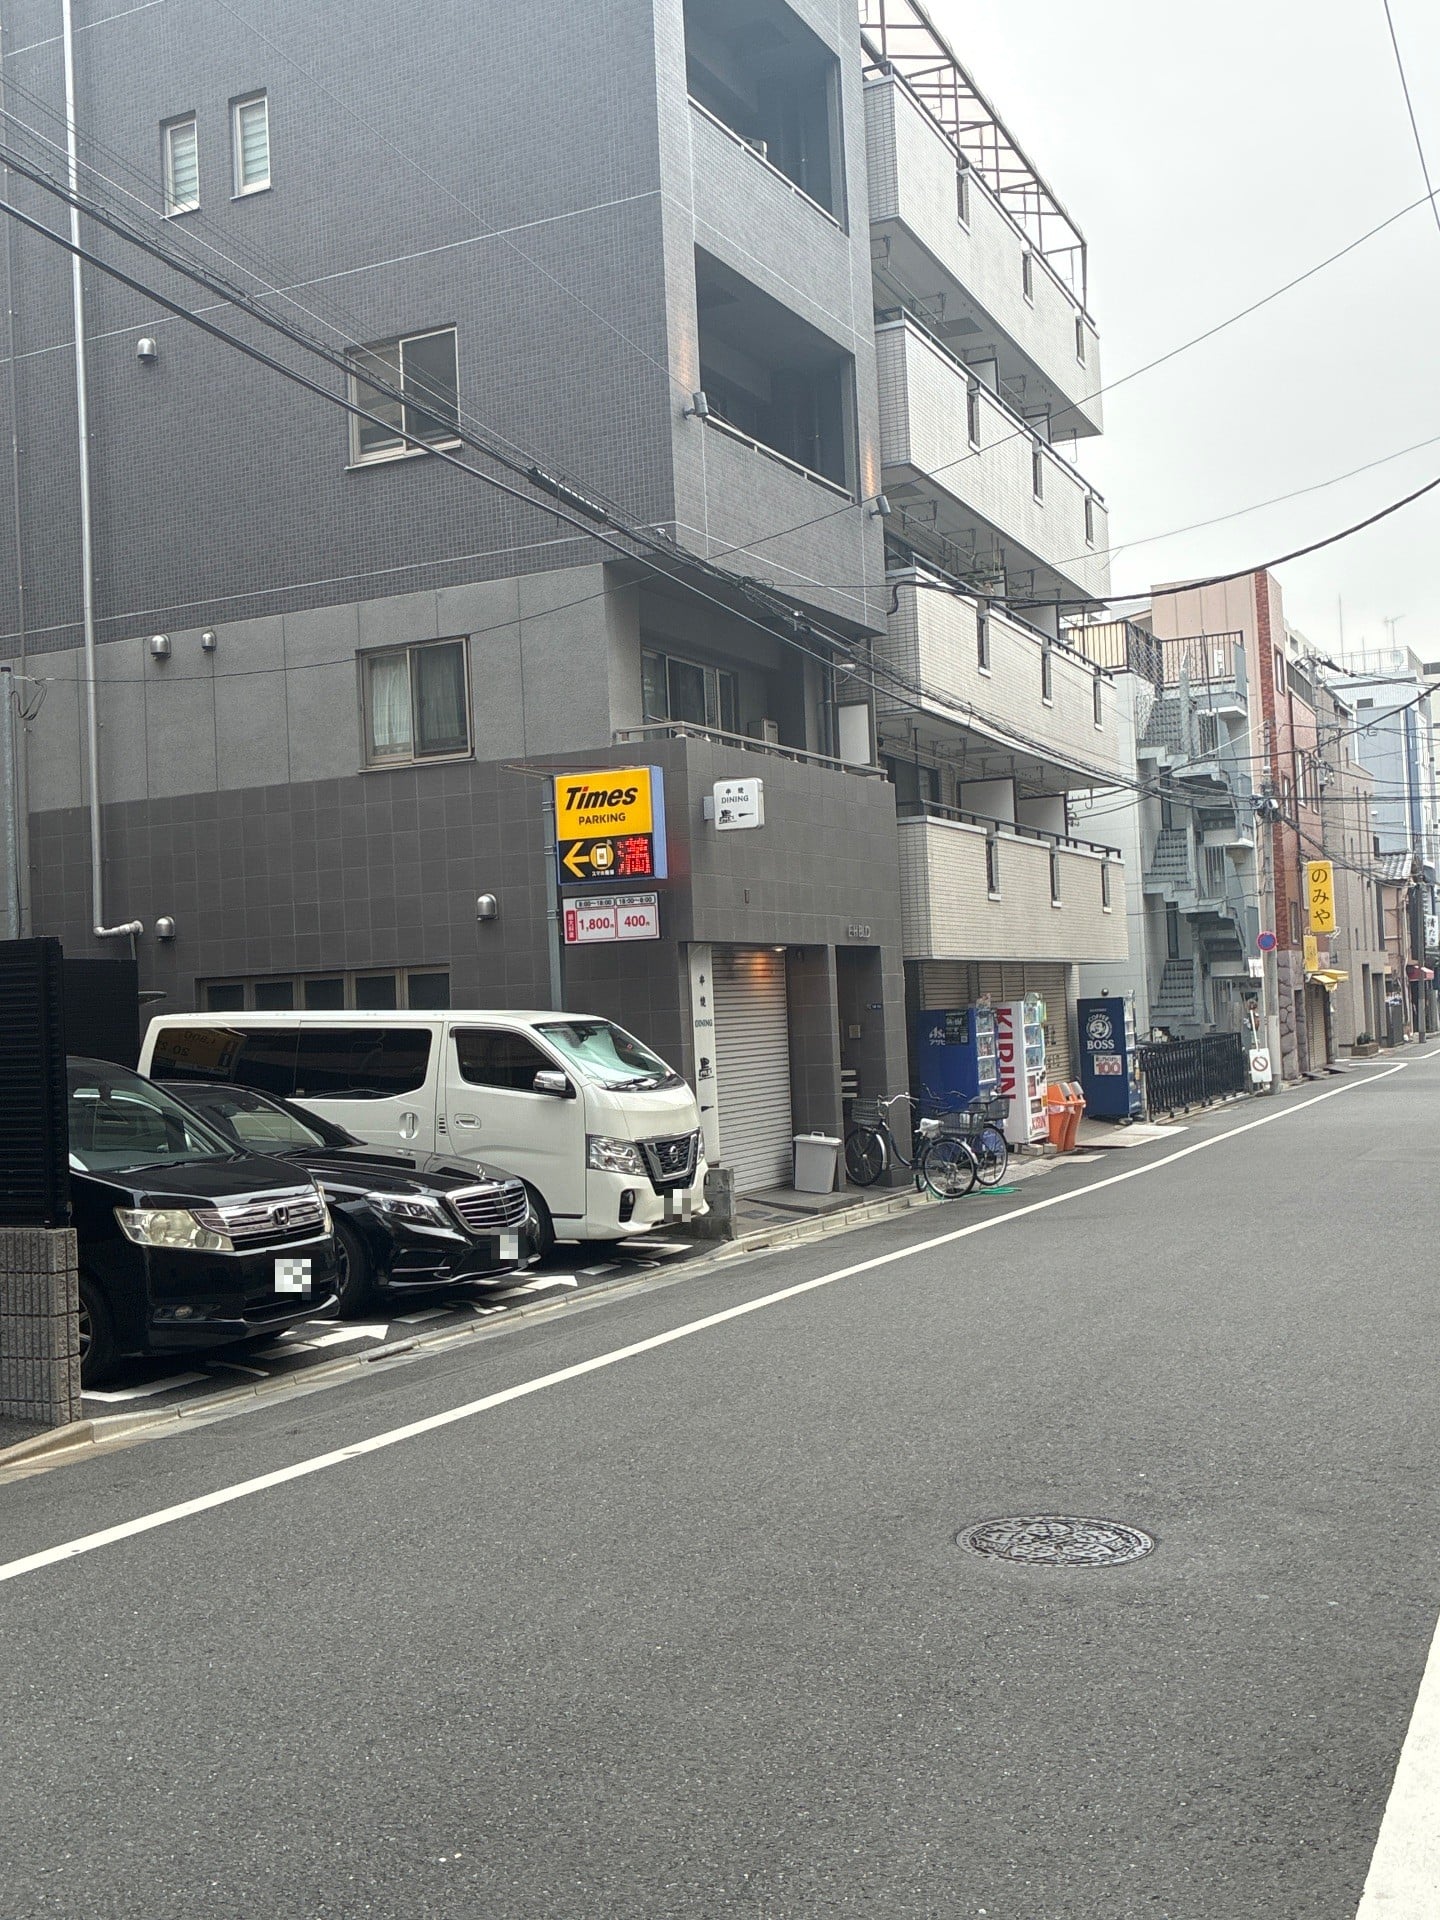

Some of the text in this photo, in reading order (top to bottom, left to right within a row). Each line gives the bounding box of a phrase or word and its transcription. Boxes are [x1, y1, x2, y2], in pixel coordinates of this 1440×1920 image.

[565, 786, 638, 811] Times
[721, 795, 749, 804] DINING
[578, 813, 626, 826] PARKING
[1311, 868, 1331, 926] のみや
[997, 1008, 1017, 1100] KIRIN
[1086, 1039, 1115, 1050] BOSS
